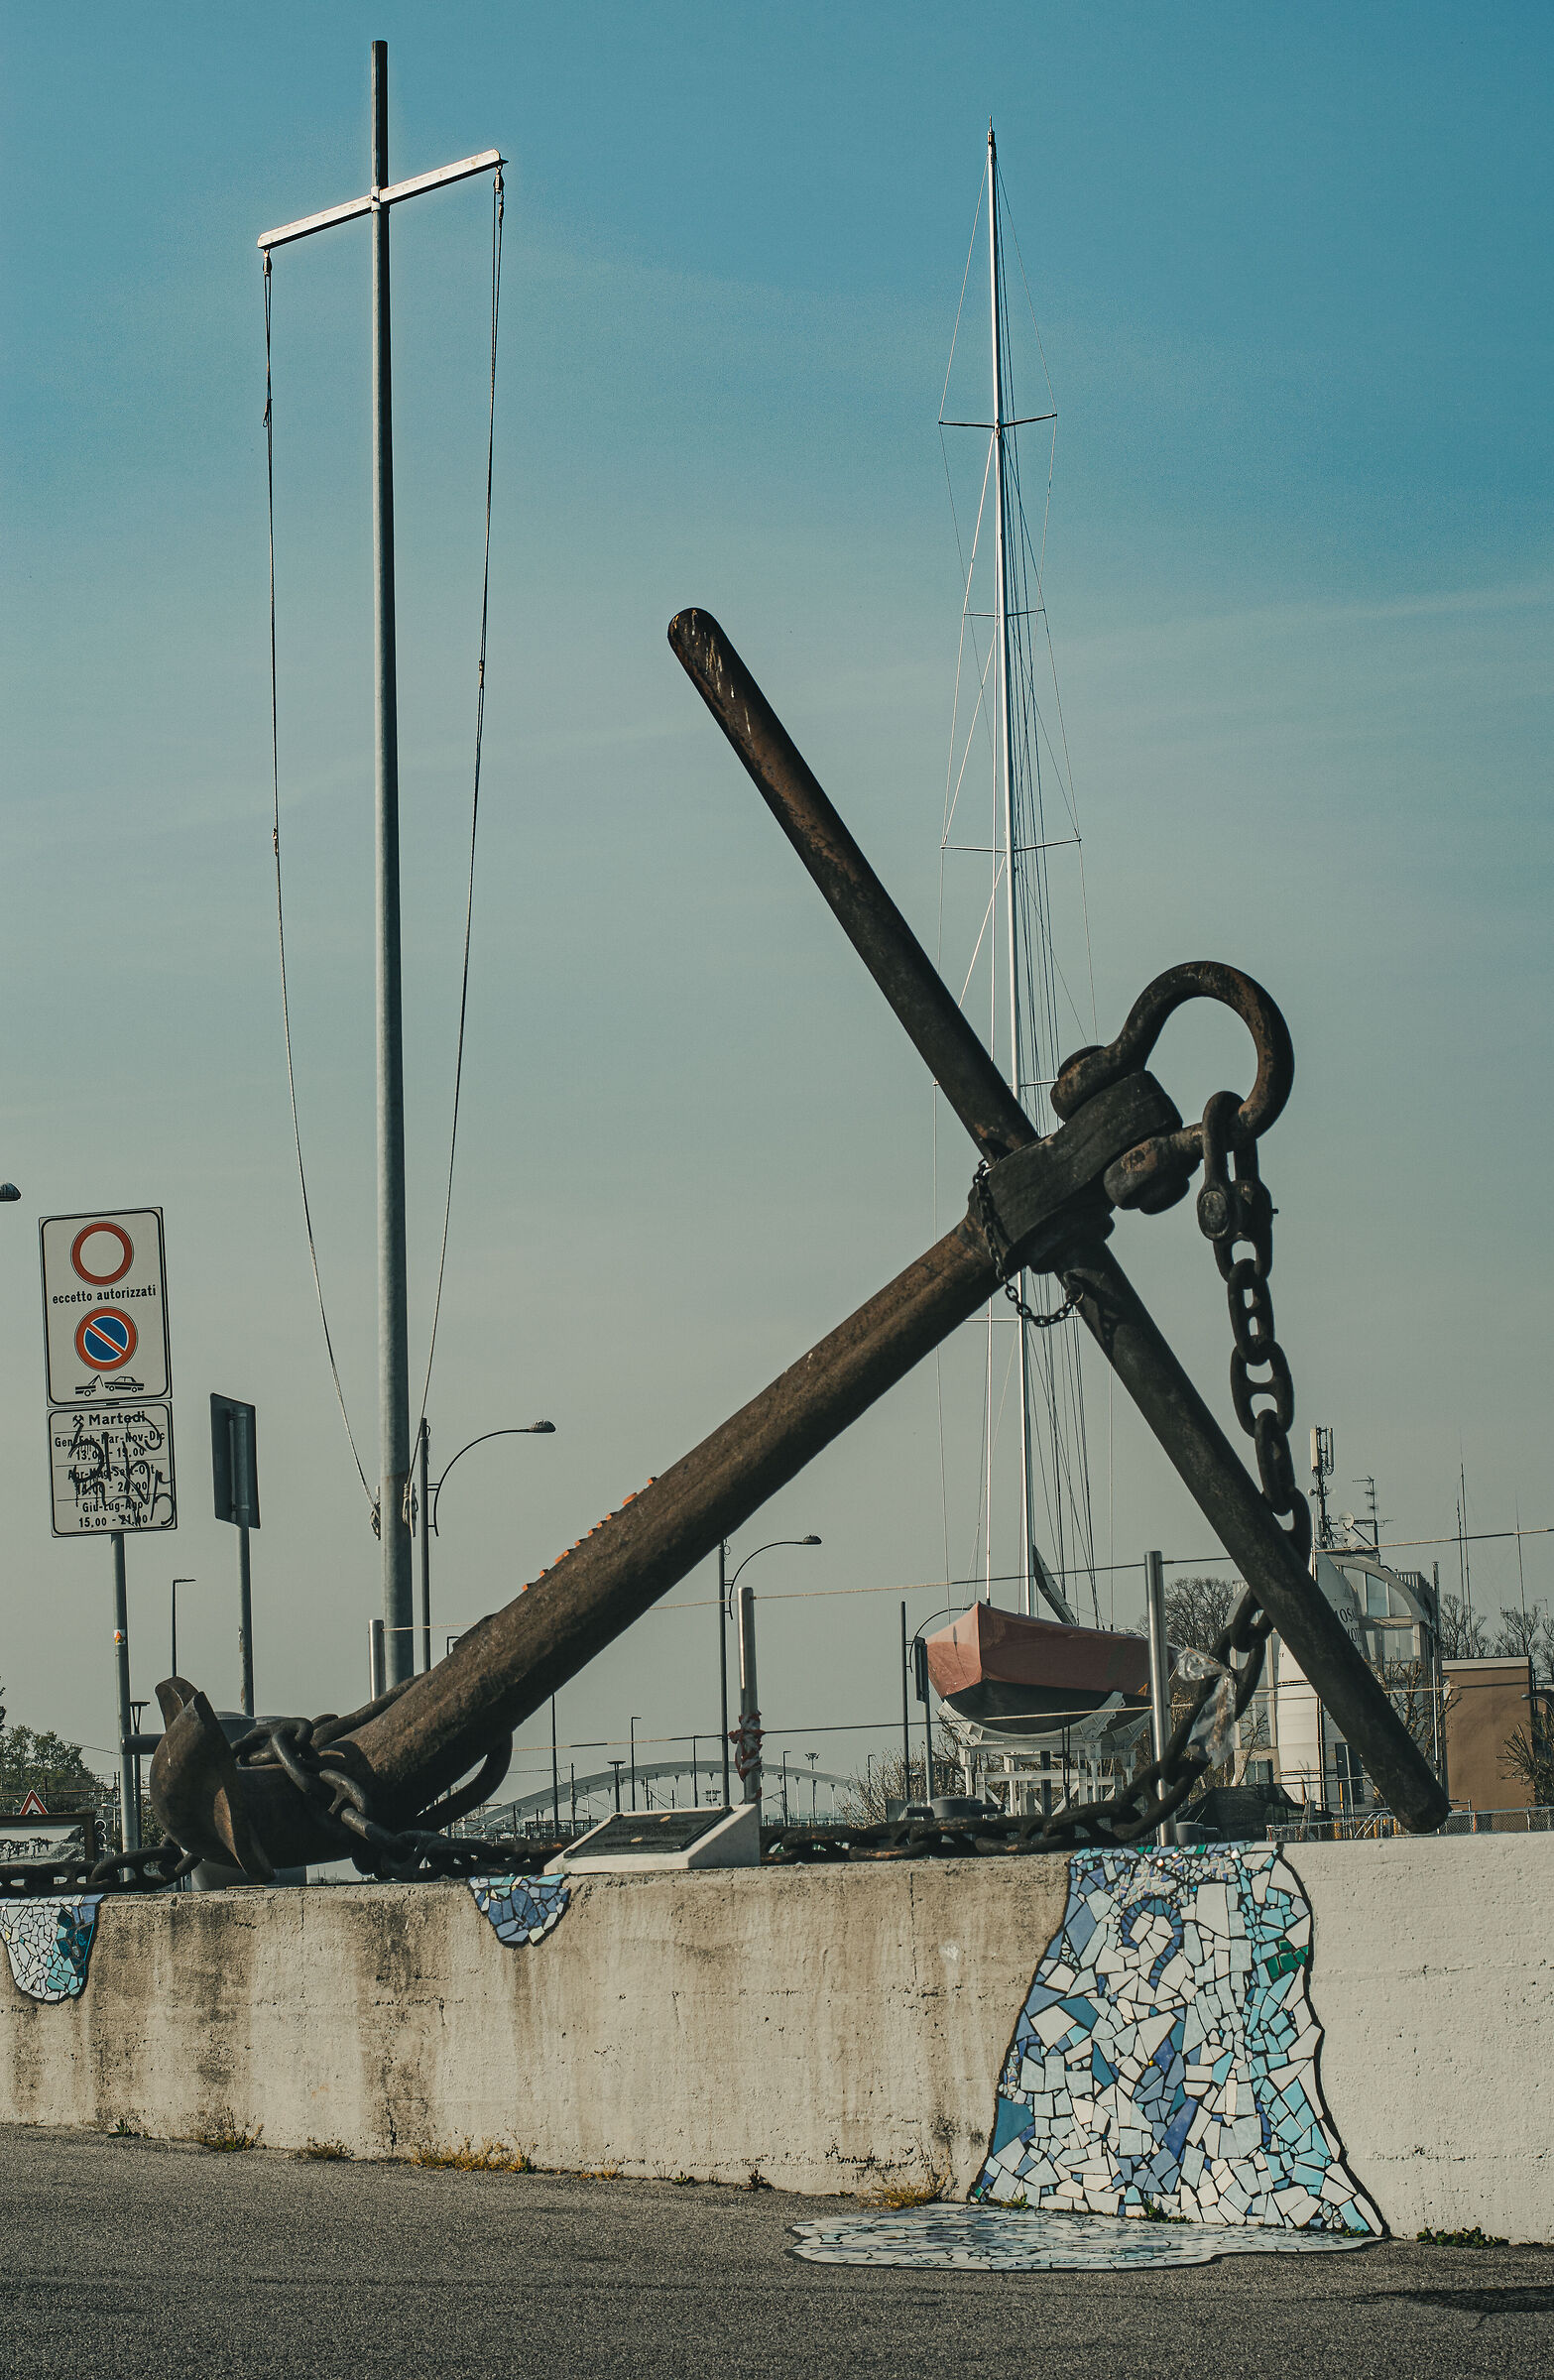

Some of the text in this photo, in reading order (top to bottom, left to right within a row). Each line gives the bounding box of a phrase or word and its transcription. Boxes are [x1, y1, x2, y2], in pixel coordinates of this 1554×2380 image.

[53, 1284, 157, 1304] eccetto autorizzati
[76, 1447, 104, 1461] 13.0
[118, 1481, 147, 1492] 2.00
[79, 1516, 106, 1528] 15.00
